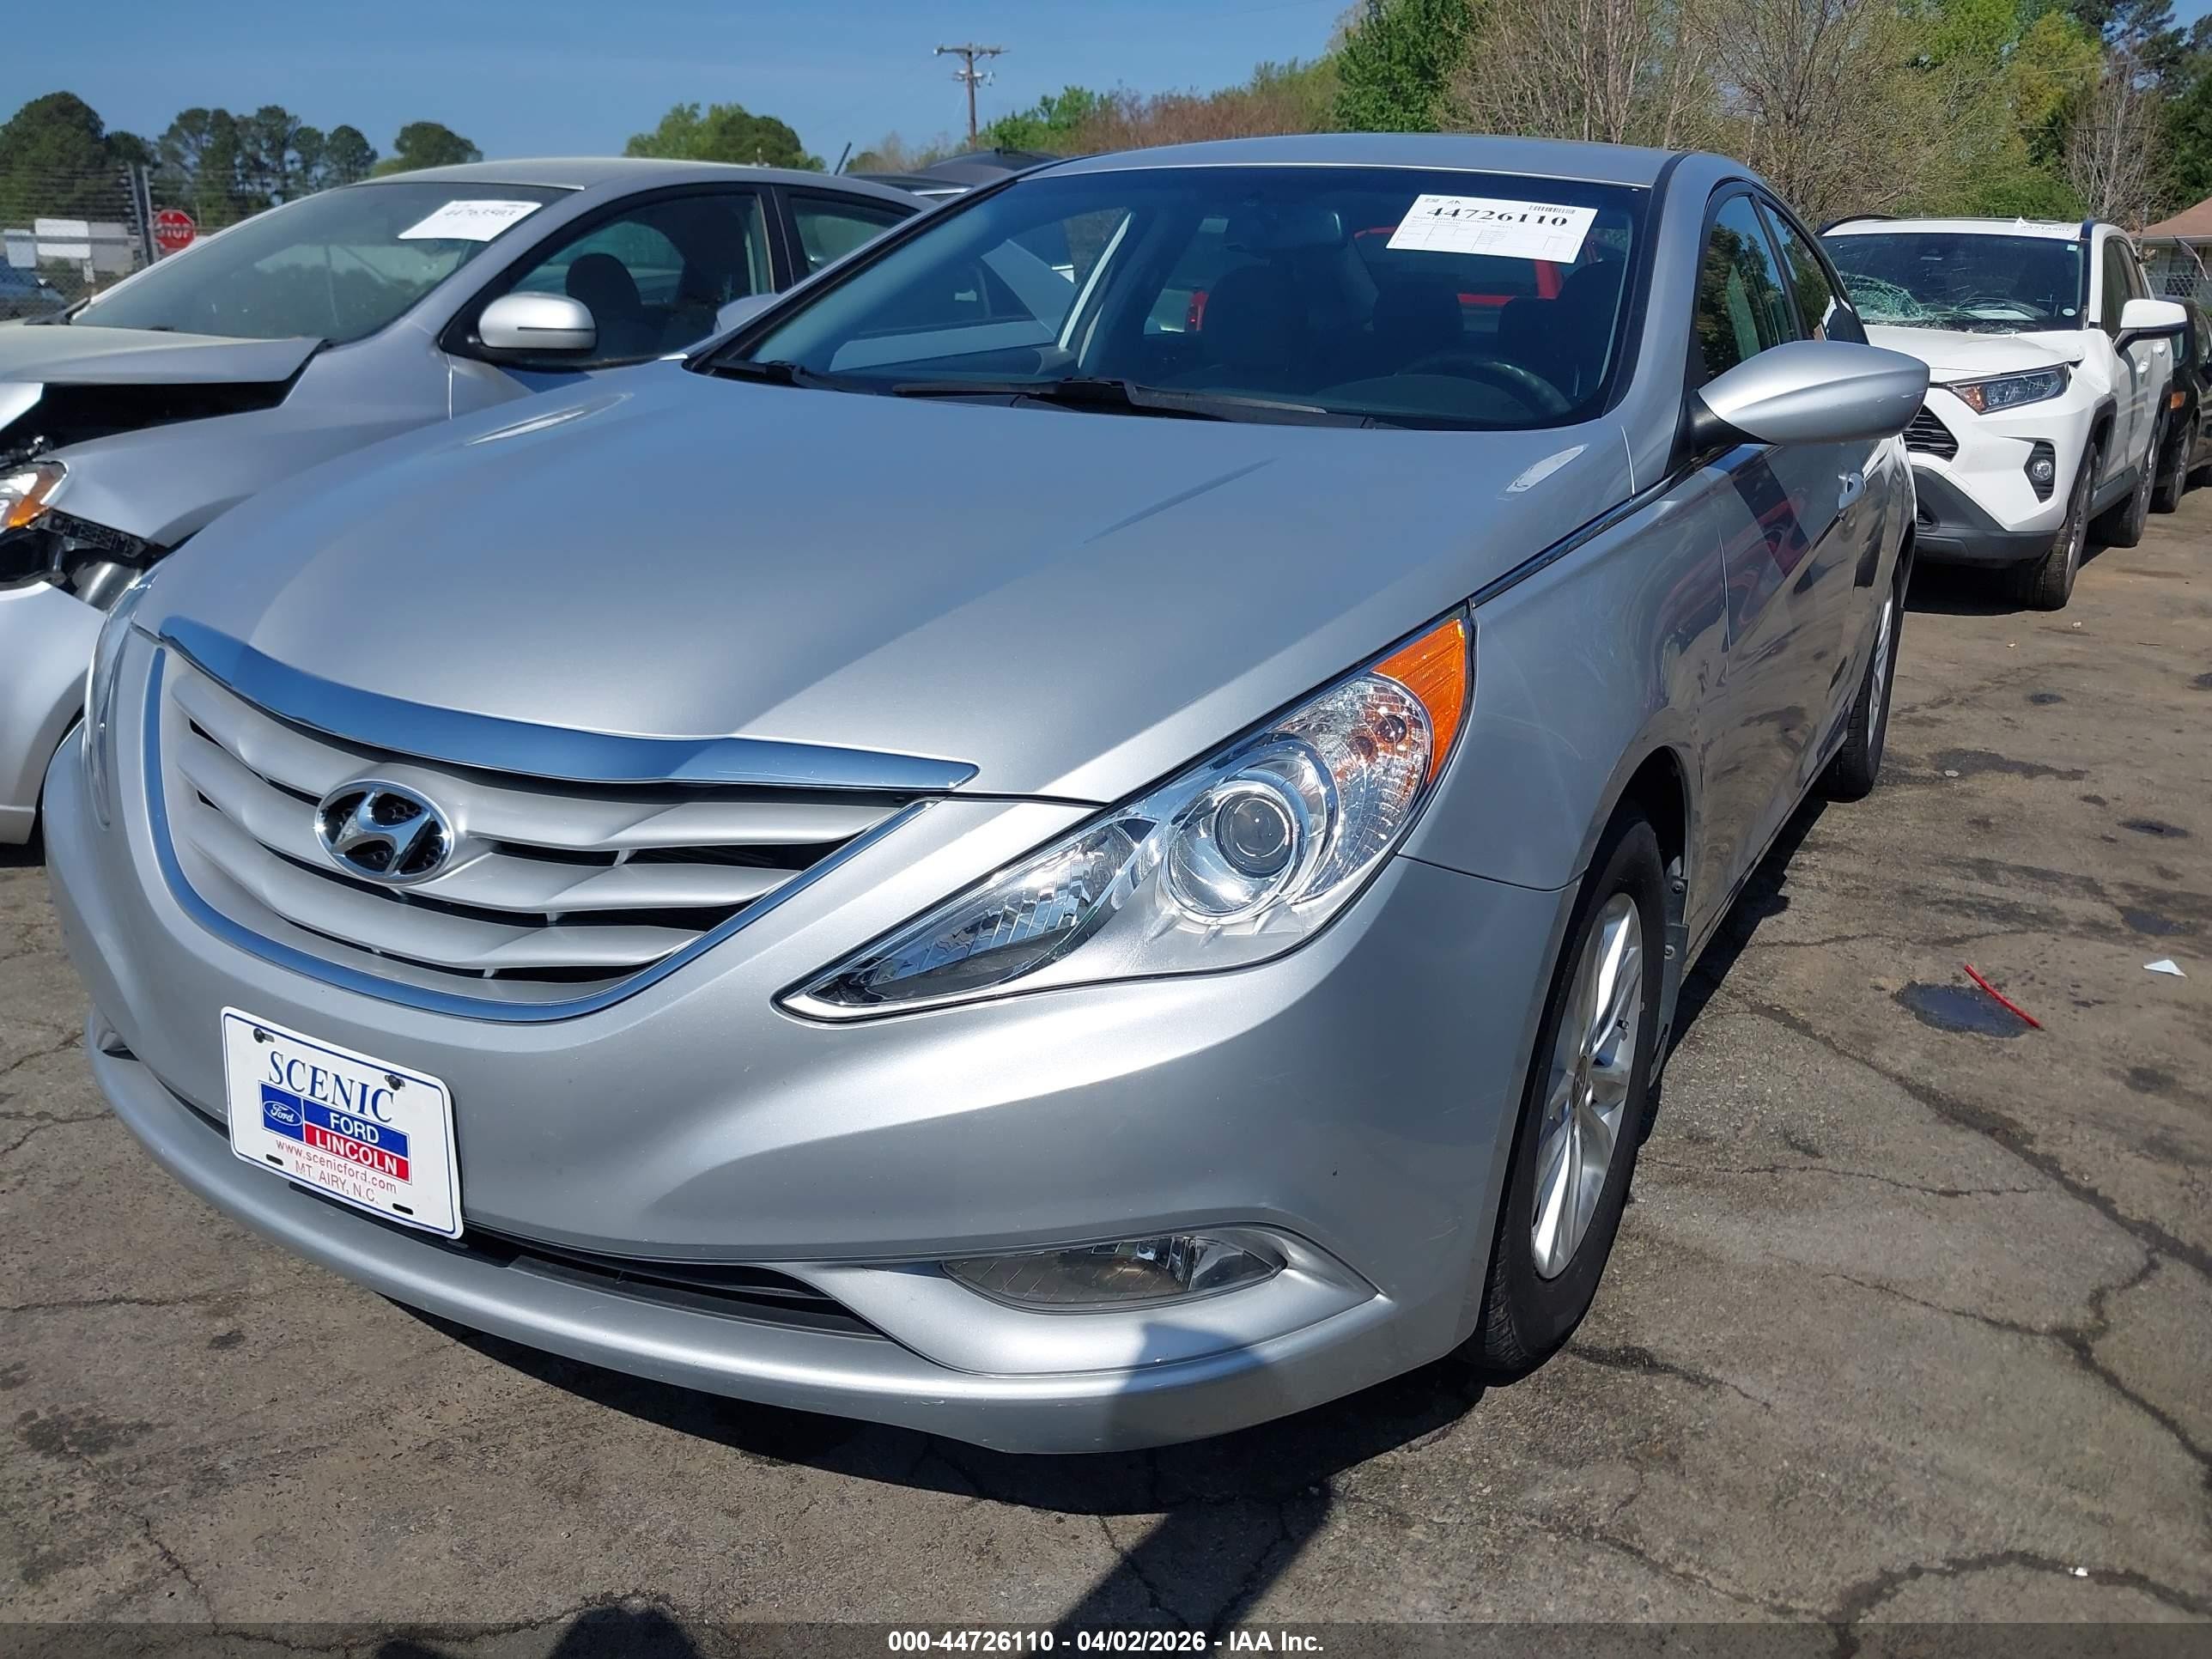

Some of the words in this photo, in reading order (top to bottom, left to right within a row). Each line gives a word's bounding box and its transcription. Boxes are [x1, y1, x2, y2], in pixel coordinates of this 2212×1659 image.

[156, 222, 191, 240] STOP
[1427, 207, 1568, 227] 44726110
[269, 1050, 395, 1123] SCENIC
[270, 1103, 295, 1123] Ford
[330, 1112, 380, 1145] FORD
[276, 1139, 398, 1194] www.scenicford.com
[315, 1130, 398, 1176] LINCOLN
[319, 1170, 349, 1195] AIRY,
[353, 1182, 380, 1205] N.C.
